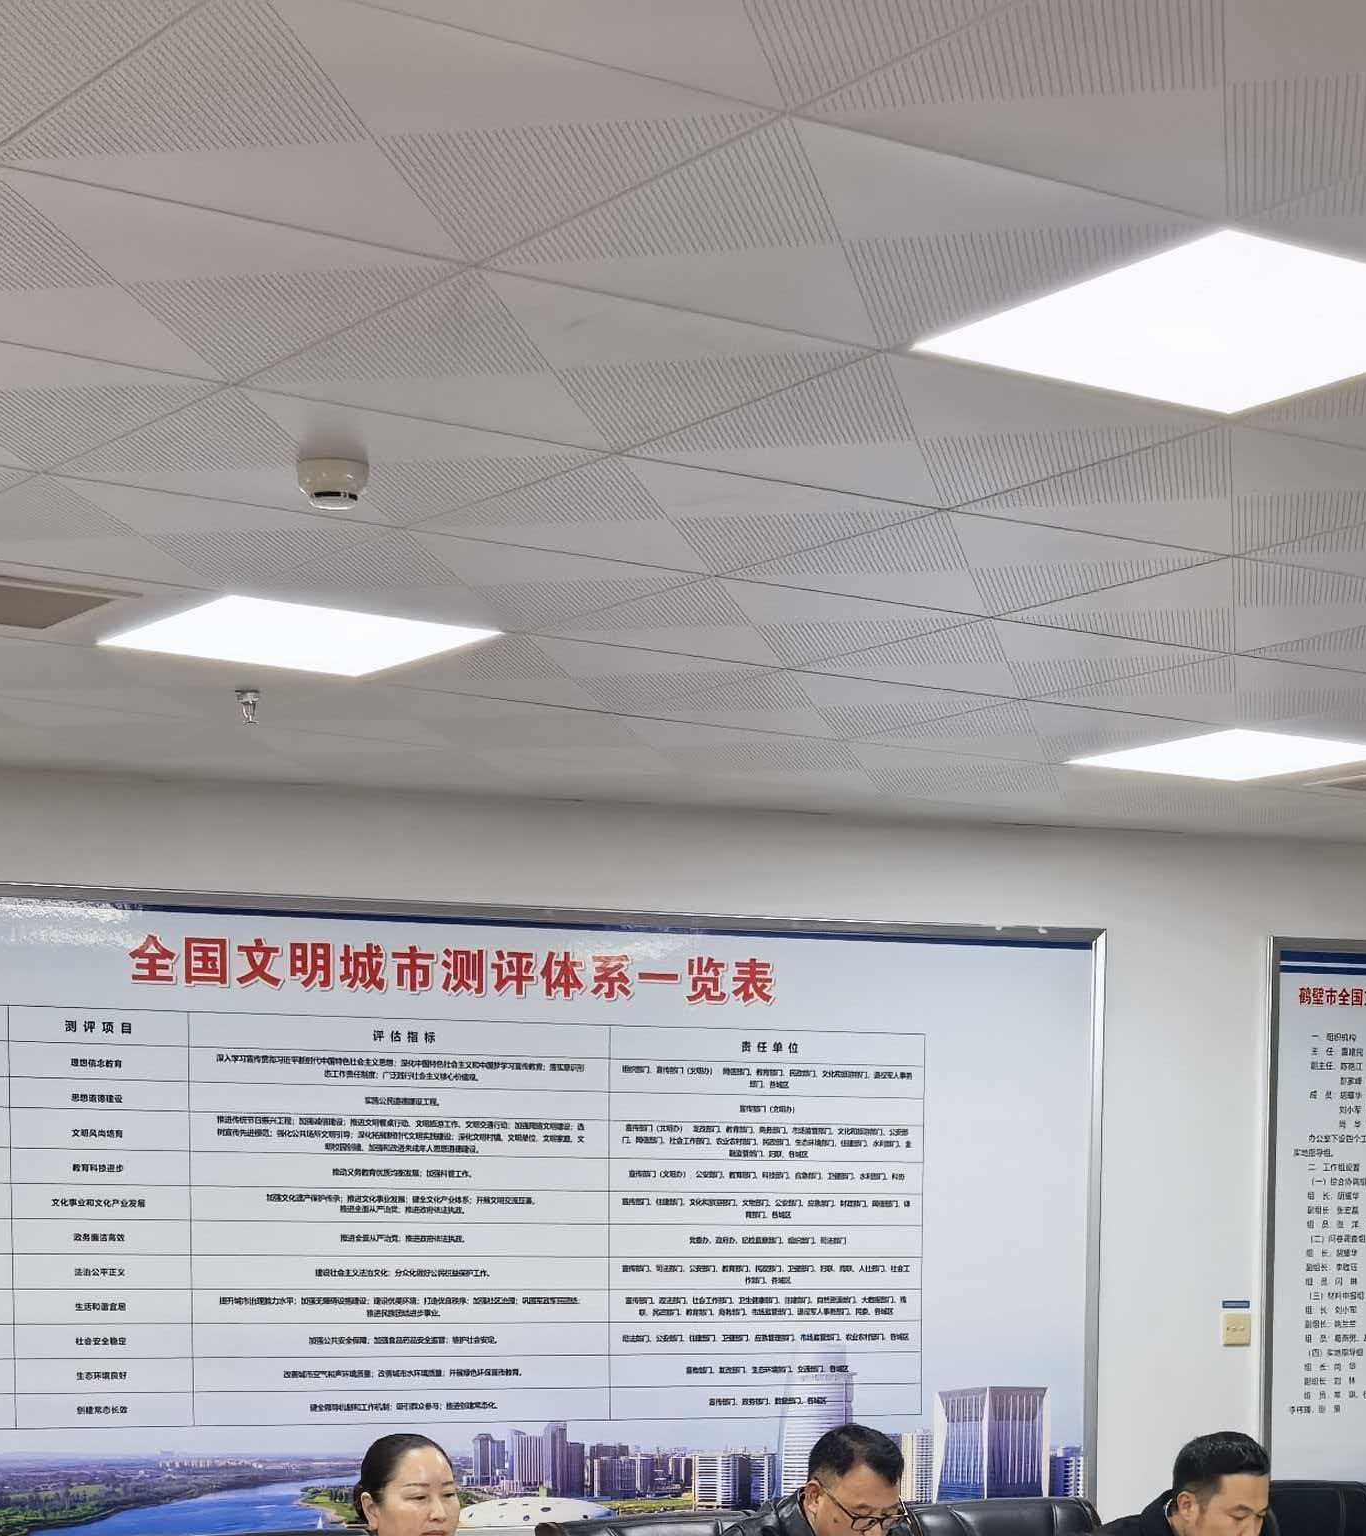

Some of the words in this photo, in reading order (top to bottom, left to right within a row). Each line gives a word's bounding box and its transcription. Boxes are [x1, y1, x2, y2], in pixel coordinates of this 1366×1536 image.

[129, 934, 777, 1008] 全国文明城市测评体系一览表
[65, 1020, 133, 1034] 测评项目
[372, 1029, 437, 1045] 评估指标
[741, 1040, 799, 1054] 责任单位
